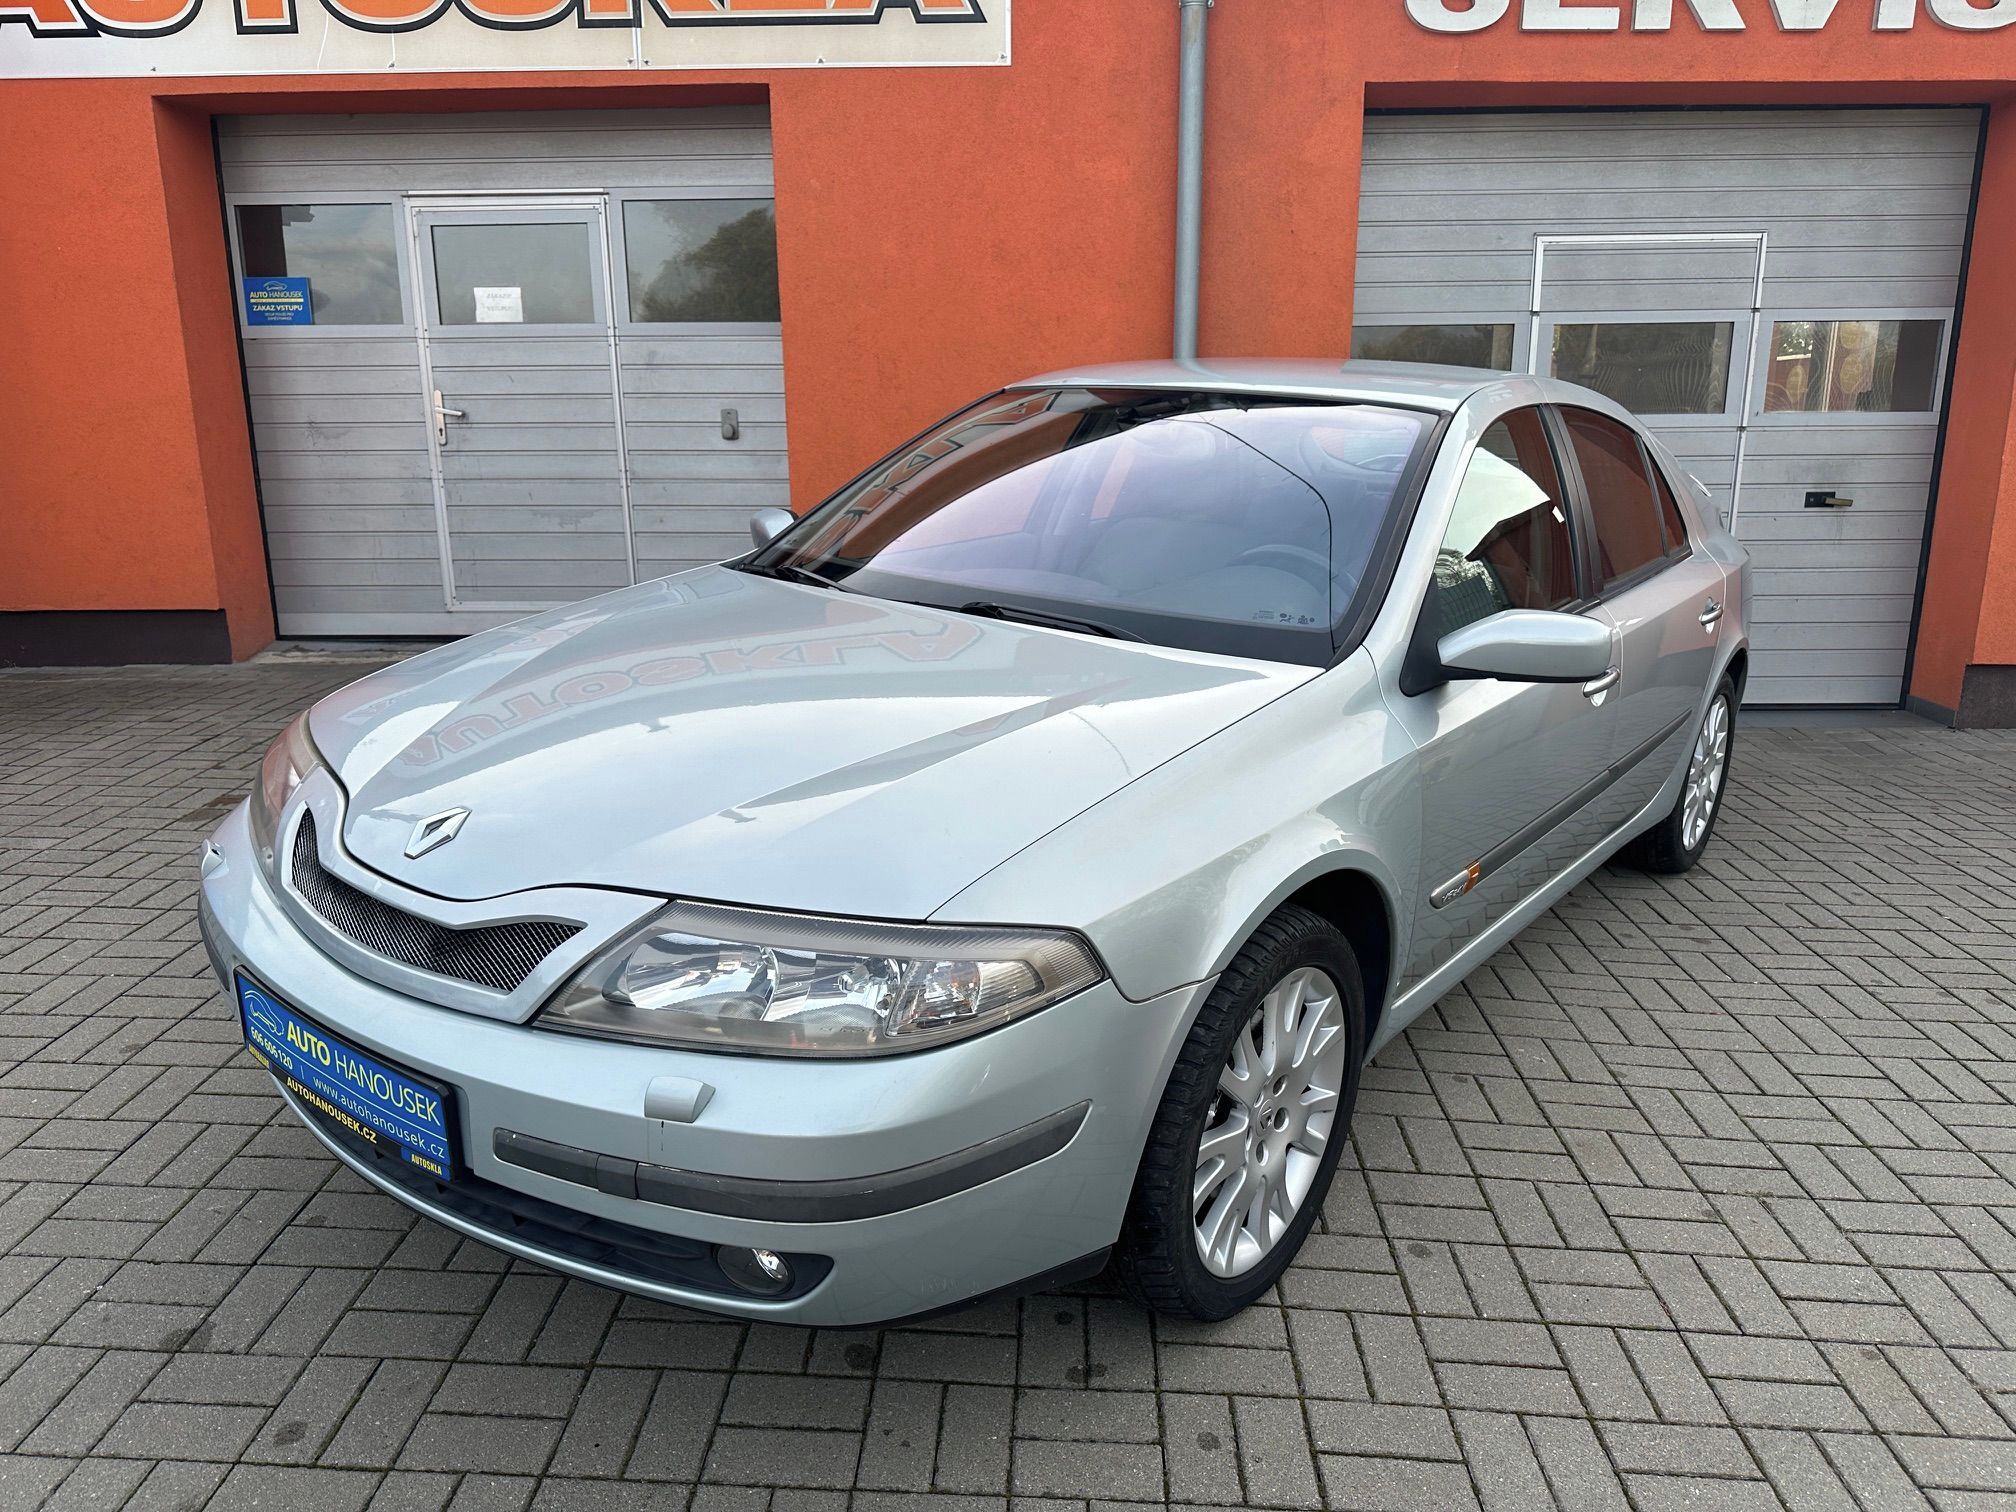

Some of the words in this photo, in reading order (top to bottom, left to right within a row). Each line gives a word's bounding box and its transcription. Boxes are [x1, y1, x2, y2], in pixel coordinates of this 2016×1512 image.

[278, 1049, 293, 1070] 120
[312, 1076, 446, 1159] www.autohanousek.cz
[286, 1020, 331, 1065] AUTO
[335, 1049, 441, 1126] HANOUSEK
[286, 1076, 378, 1145] AUTOHANOUSEK.CZ
[411, 1153, 443, 1176] AUTOSKLA
